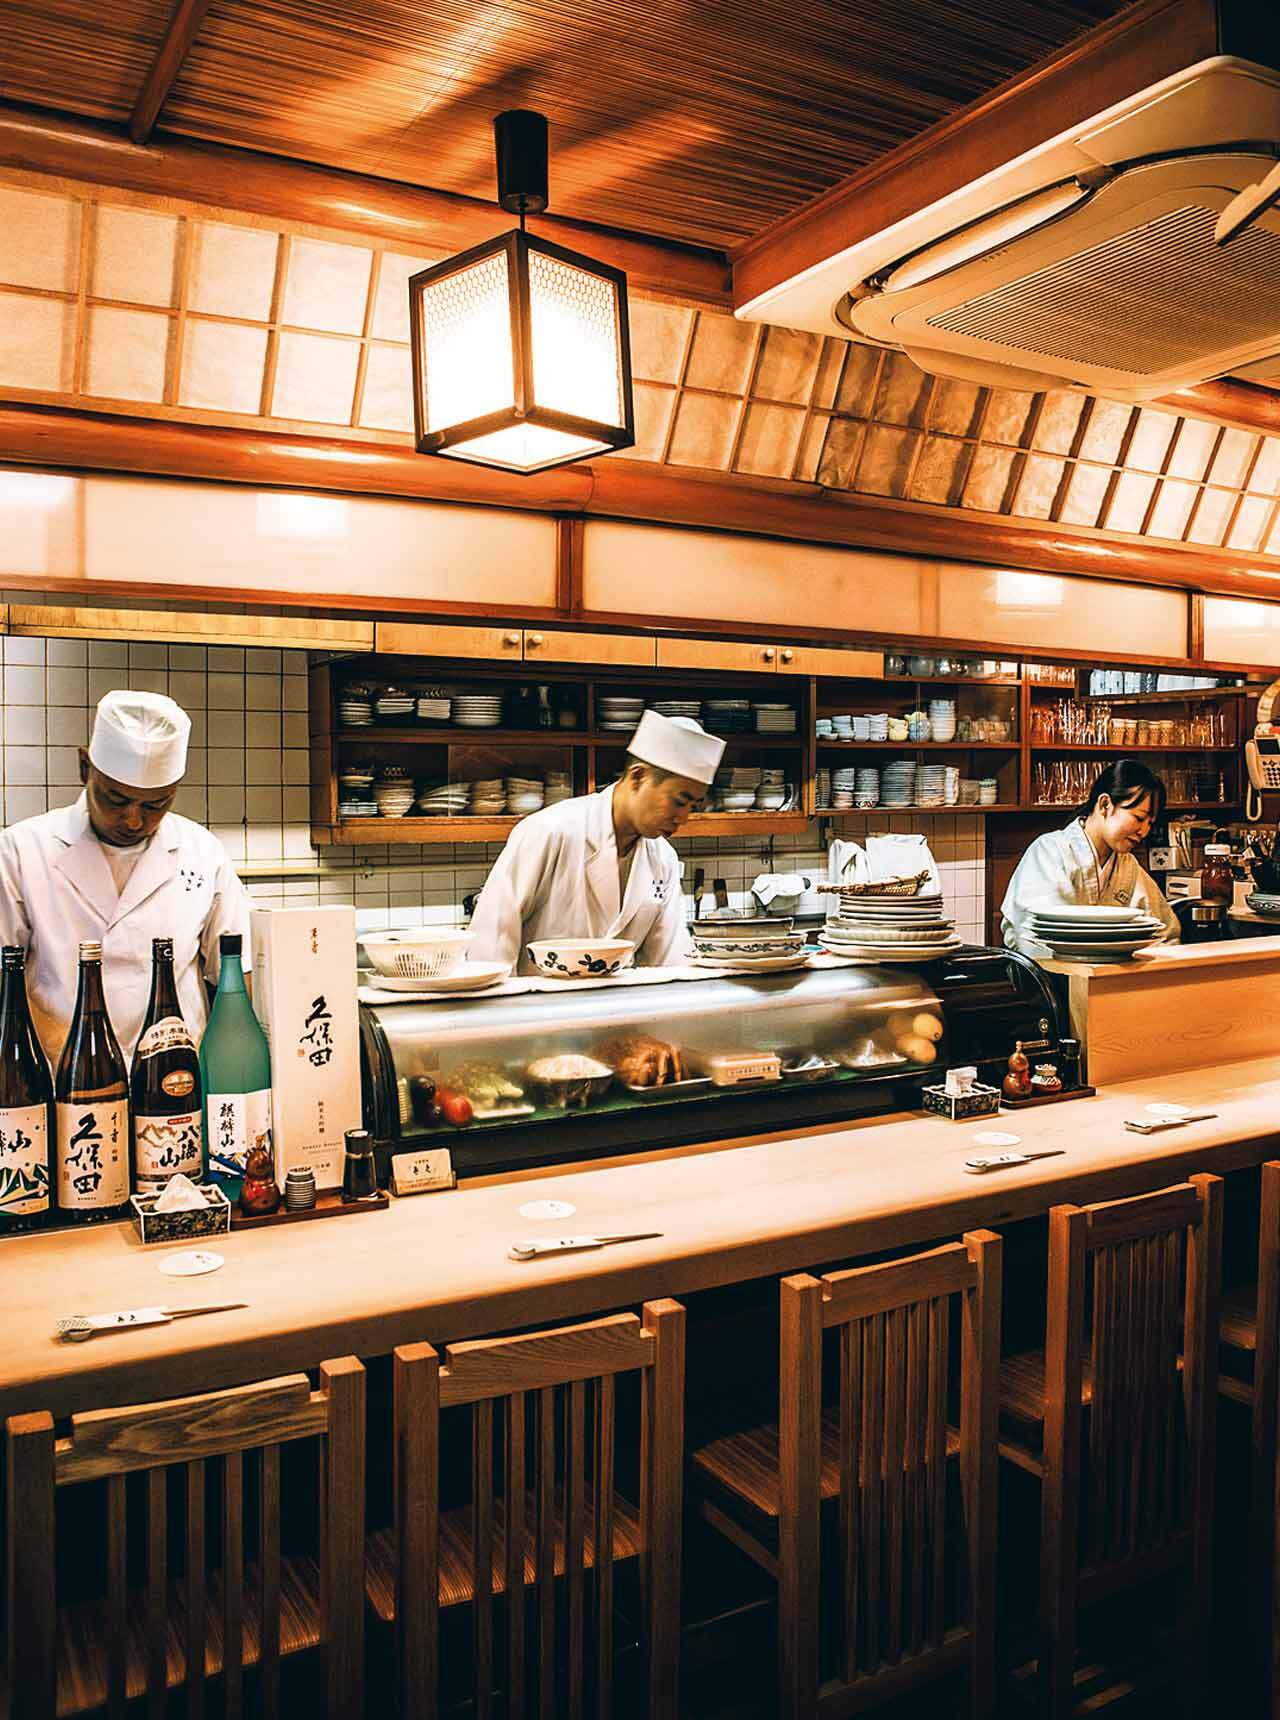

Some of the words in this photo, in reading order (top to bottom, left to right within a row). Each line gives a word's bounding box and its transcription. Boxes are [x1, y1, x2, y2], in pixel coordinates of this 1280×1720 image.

[299, 995, 333, 1067] 久保田
[65, 1112, 104, 1195] 久保田
[159, 1125, 200, 1169] 八海山
